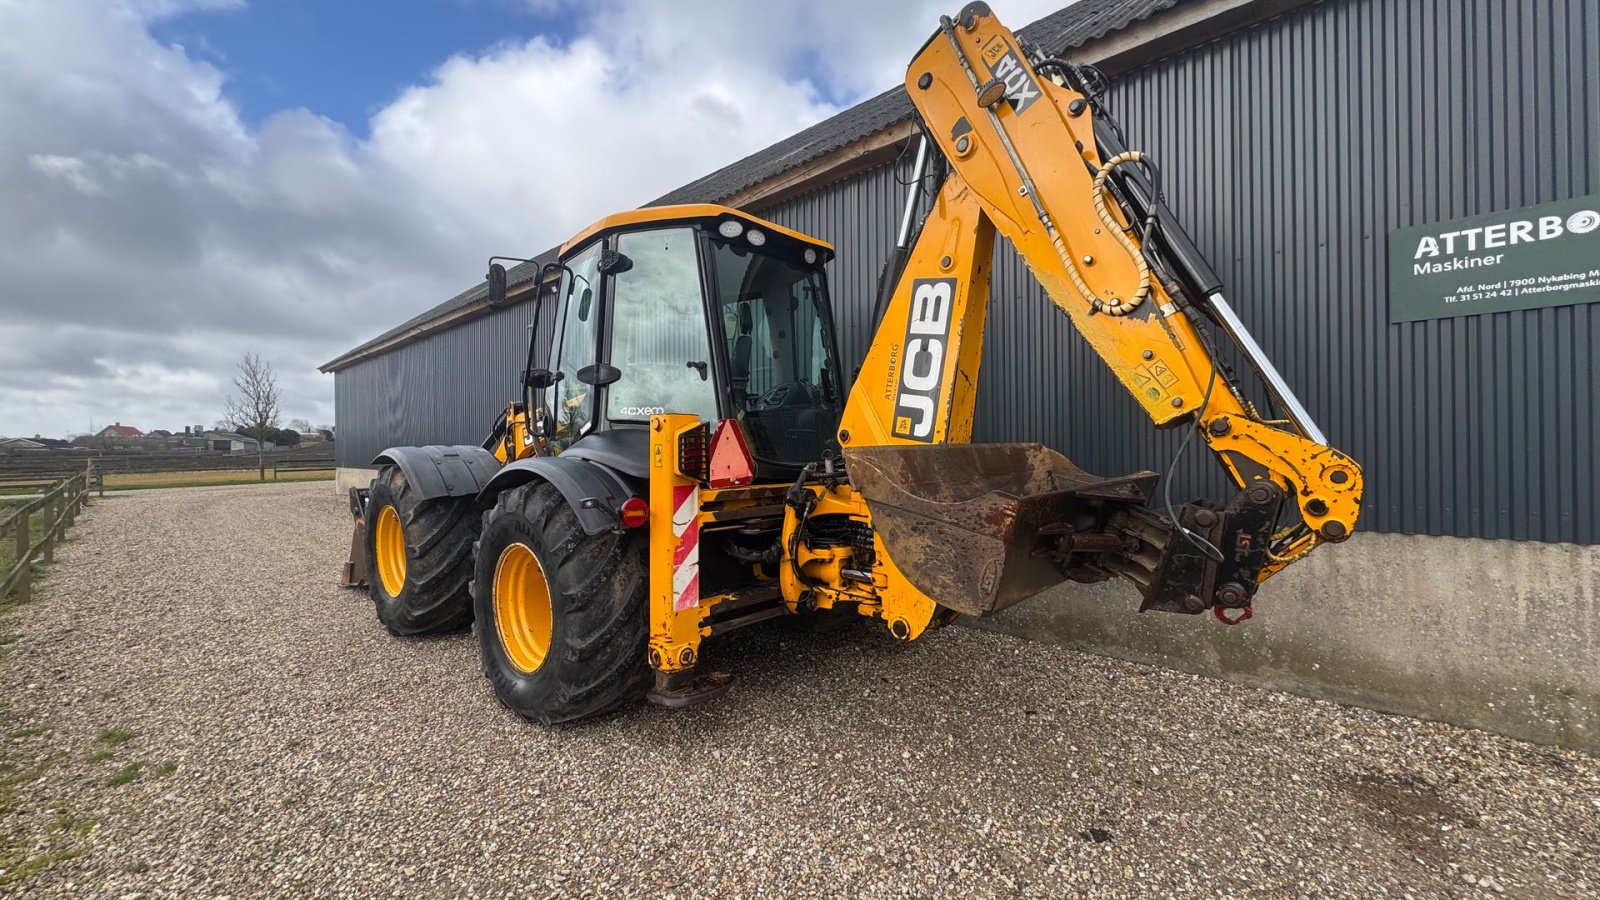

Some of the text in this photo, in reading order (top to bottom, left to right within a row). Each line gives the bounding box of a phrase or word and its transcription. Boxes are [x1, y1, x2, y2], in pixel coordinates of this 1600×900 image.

[1413, 253, 1505, 275] Maskiner
[1456, 285, 1475, 294] Afd.
[1478, 282, 1501, 291] Nord
[1509, 278, 1535, 287] 7900
[1538, 272, 1586, 284] Nykøbing
[1588, 269, 1600, 277] M
[1460, 294, 1470, 302] 31
[1472, 292, 1482, 300] 51
[1485, 291, 1497, 299] 24
[1500, 289, 1512, 297] 42
[884, 343, 899, 401] ATTERBORG
[899, 282, 951, 437] JCB
